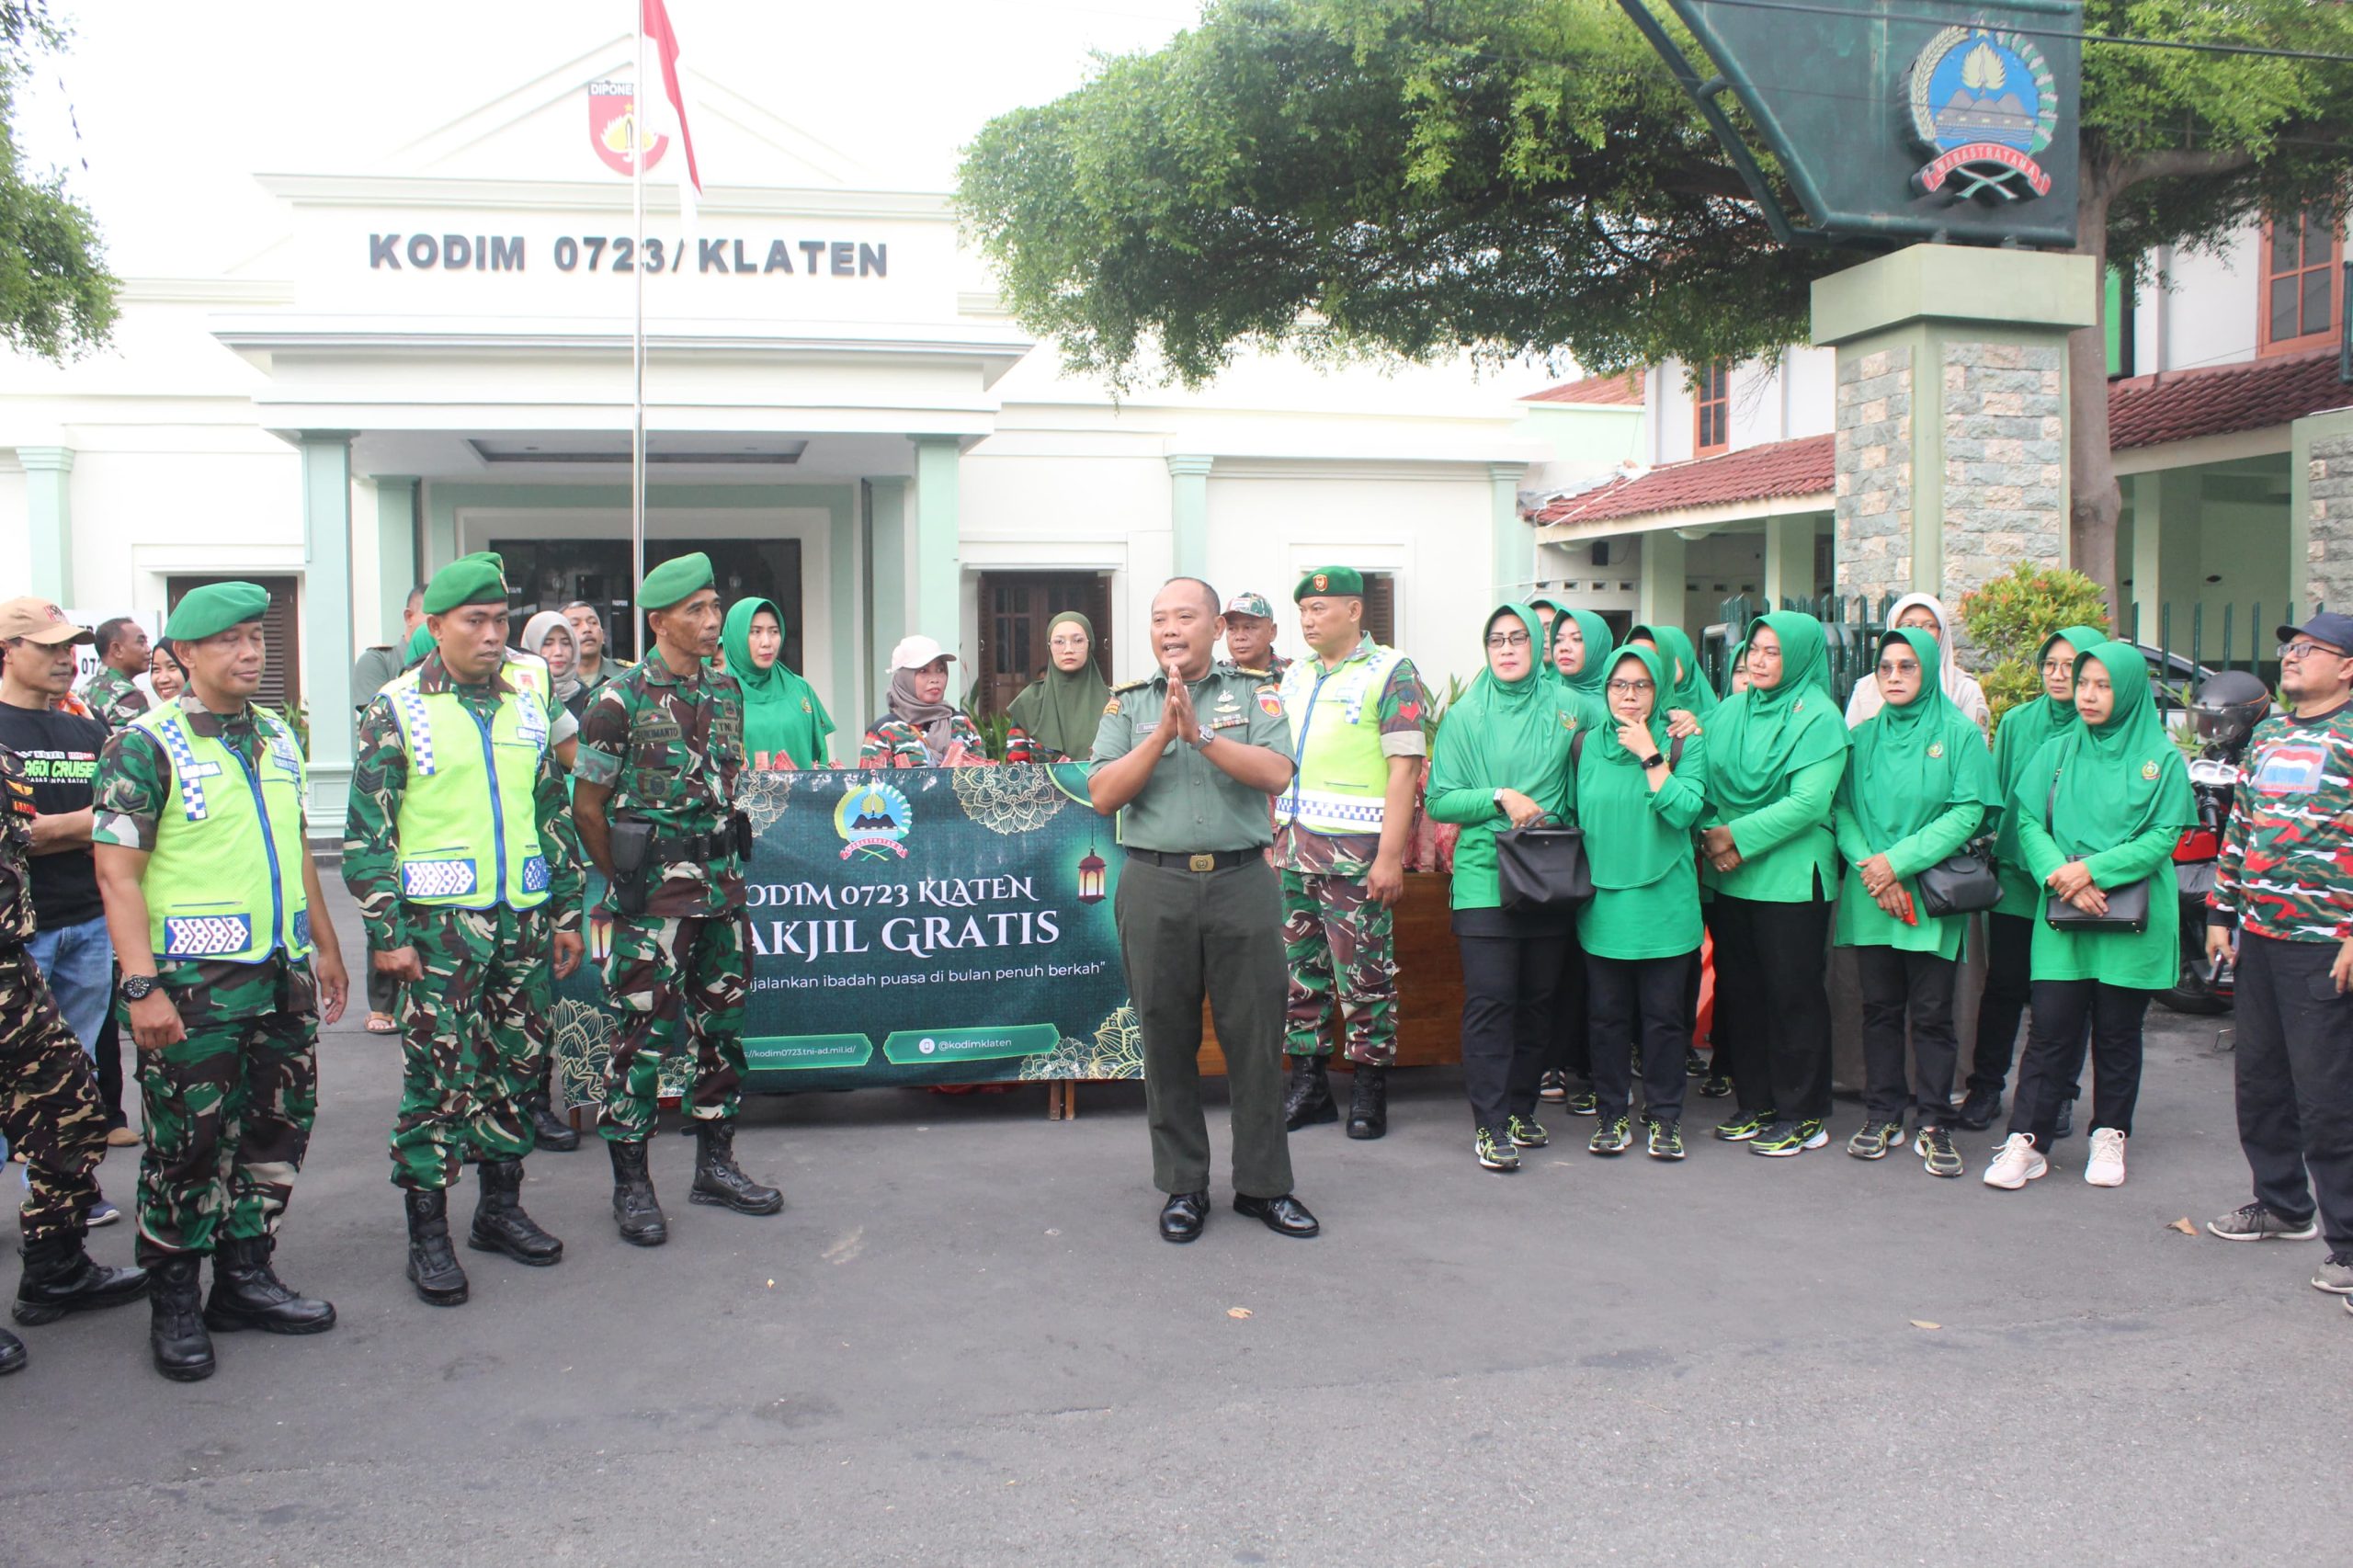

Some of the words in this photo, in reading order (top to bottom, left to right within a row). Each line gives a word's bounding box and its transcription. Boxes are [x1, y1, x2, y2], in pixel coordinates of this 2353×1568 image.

[591, 84, 632, 96] DIPONE
[1937, 146, 2036, 176] WARASTRATAMA
[369, 234, 525, 272] KODIM
[82, 657, 101, 675] 07
[51, 761, 97, 778] CRUISE
[745, 881, 838, 910] ODIM
[841, 884, 909, 907] 0723
[917, 874, 1040, 907] KLATEN
[750, 919, 870, 963] AKJIL
[881, 910, 1060, 959] GRATIS
[823, 973, 876, 987] ibadah
[881, 973, 926, 988] puasa
[930, 970, 944, 983] di
[949, 968, 991, 982] bulan
[995, 964, 1044, 982] penuh
[744, 1045, 857, 1058] s://kodim0723.tni-ad.mil.id/
[938, 1039, 1012, 1051] @kodimklaten
